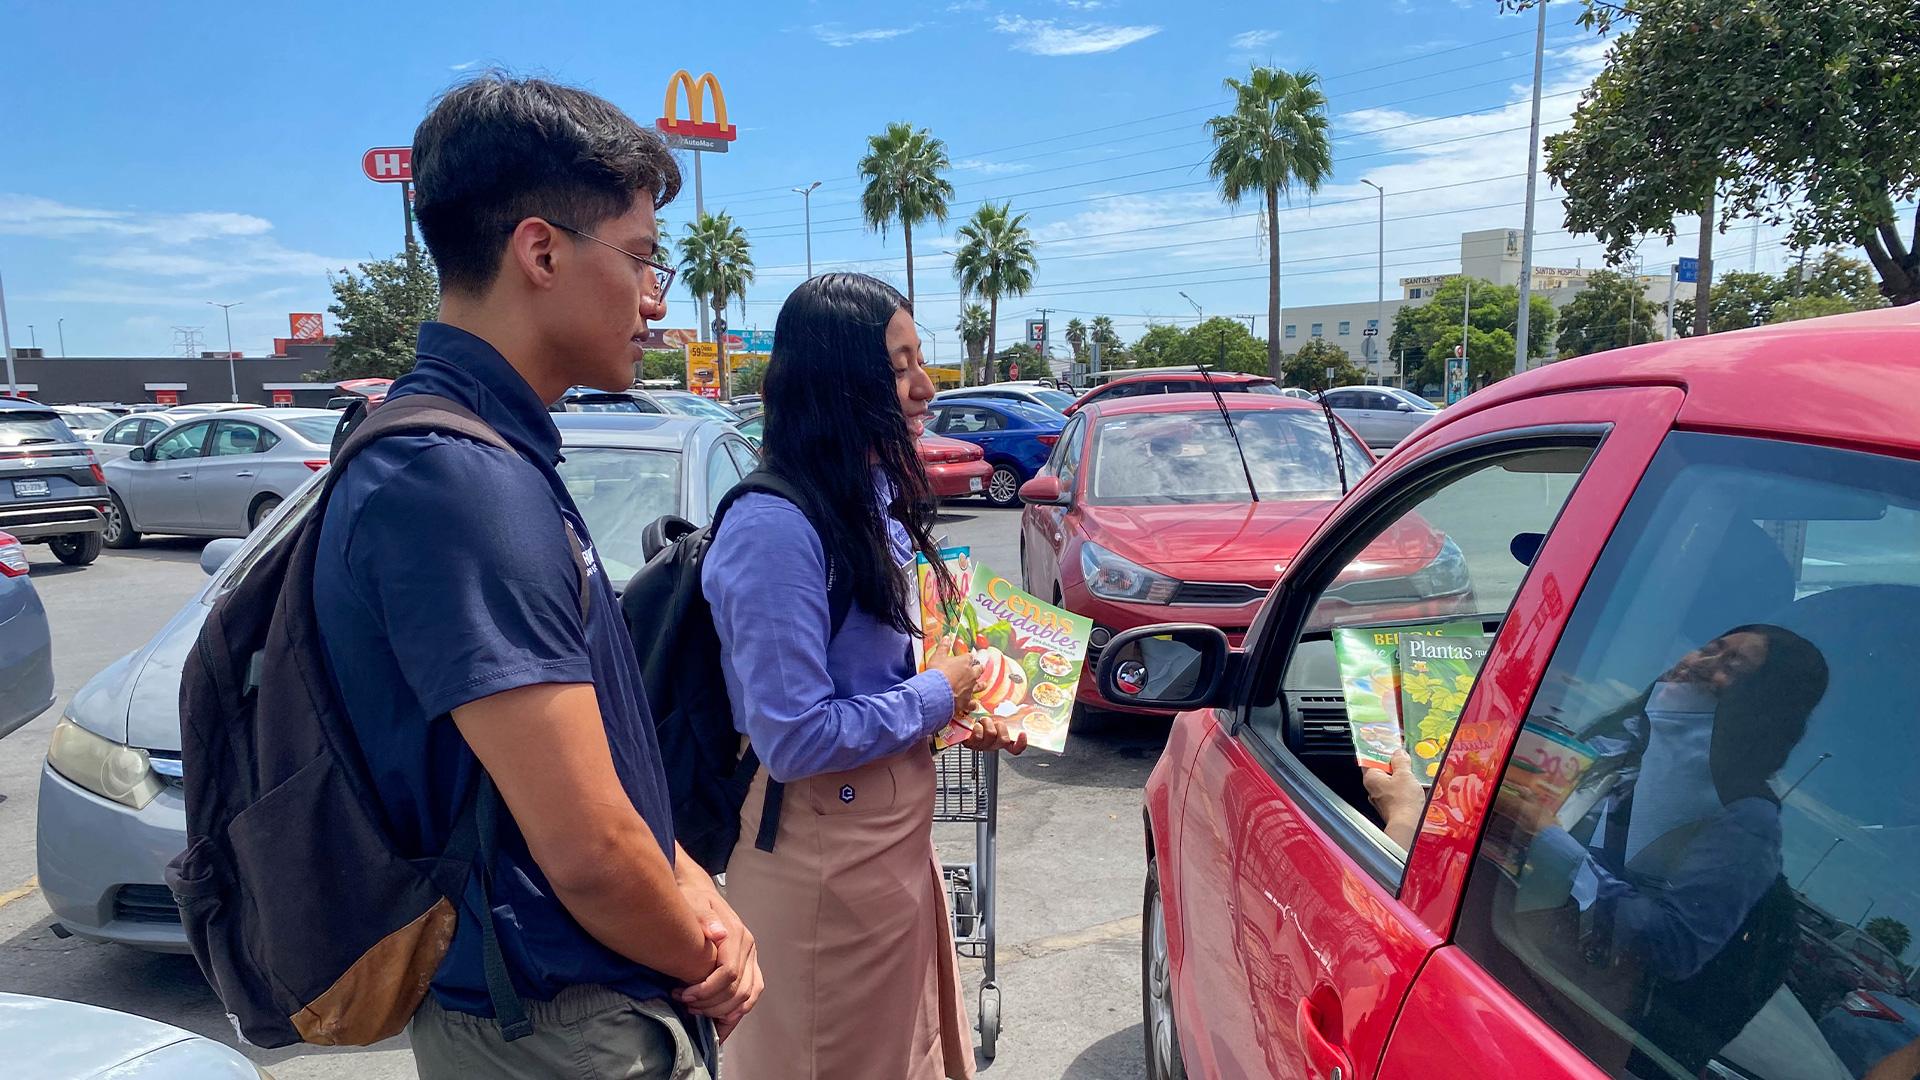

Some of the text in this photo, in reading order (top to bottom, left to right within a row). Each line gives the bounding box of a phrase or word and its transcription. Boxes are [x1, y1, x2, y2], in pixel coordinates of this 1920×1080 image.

[1536, 267, 1581, 276] SANTOS HOSPITAL
[976, 593, 1080, 649] saludables
[988, 577, 1073, 635] Cenas
[1409, 640, 1472, 660] Plantas
